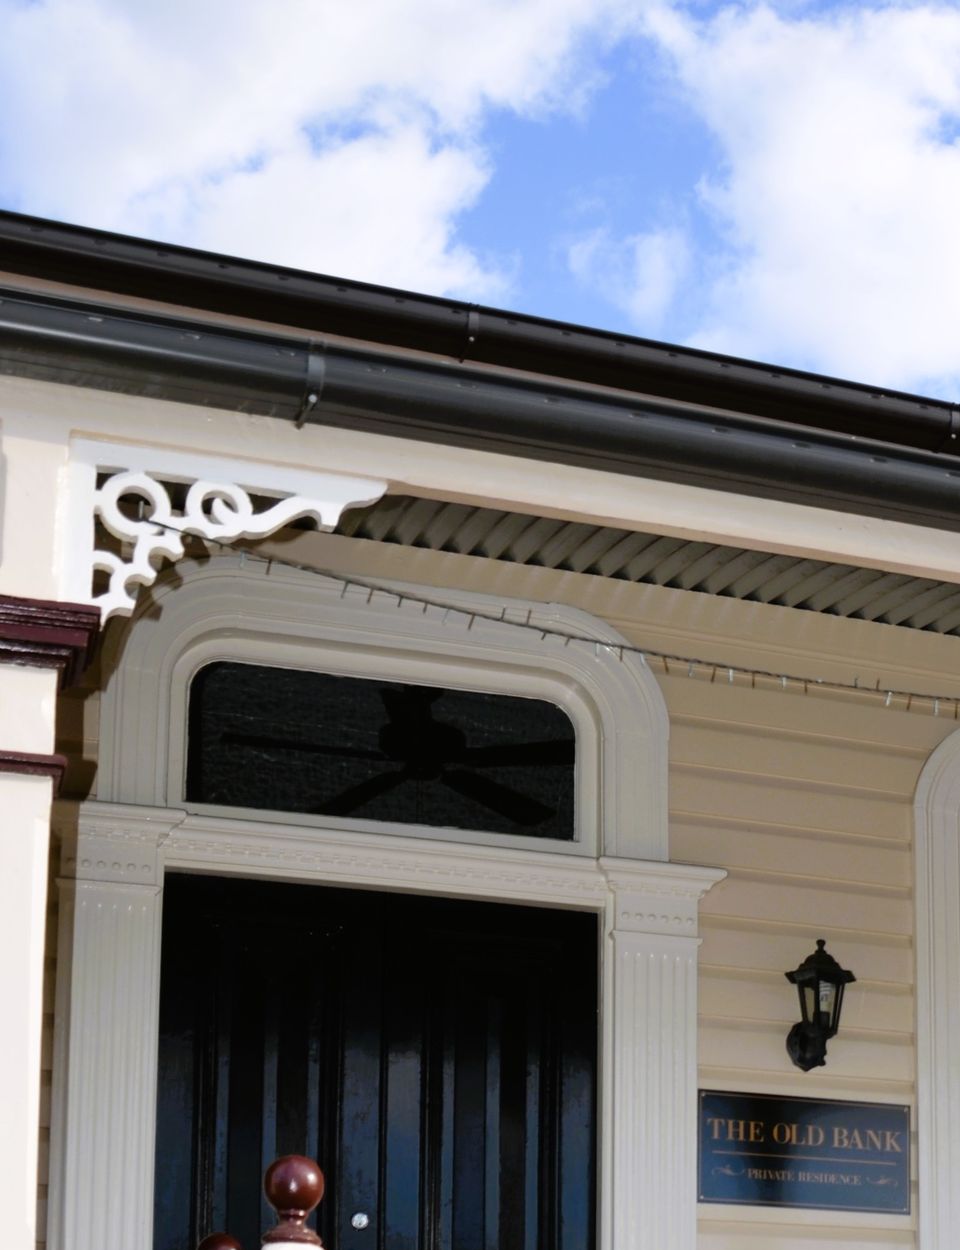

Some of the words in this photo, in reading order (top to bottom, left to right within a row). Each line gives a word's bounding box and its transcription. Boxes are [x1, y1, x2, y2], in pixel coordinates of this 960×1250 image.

[707, 1118, 764, 1143] THE
[772, 1122, 825, 1147] OLD
[832, 1126, 902, 1153] BANK
[747, 1167, 794, 1182] PRIVATE
[797, 1171, 862, 1186] RESIDENCE
